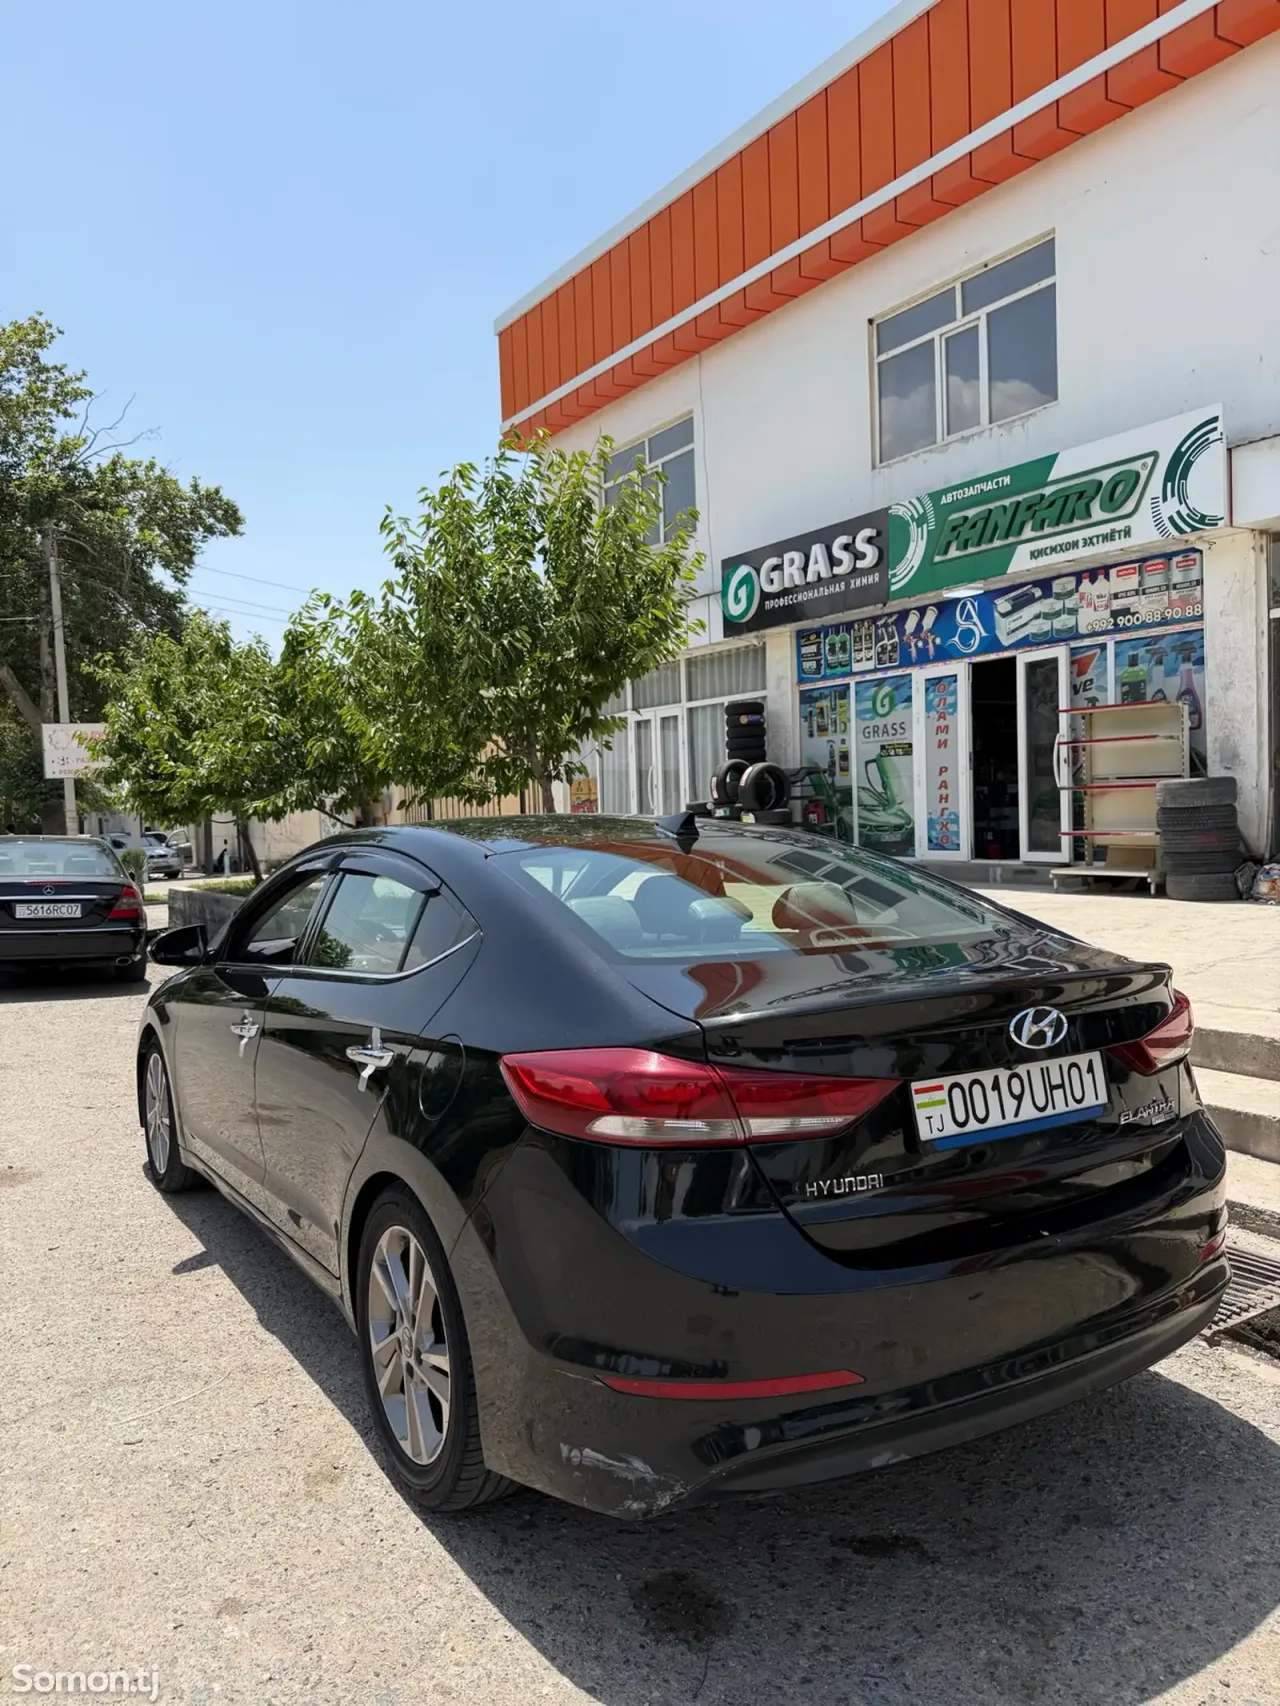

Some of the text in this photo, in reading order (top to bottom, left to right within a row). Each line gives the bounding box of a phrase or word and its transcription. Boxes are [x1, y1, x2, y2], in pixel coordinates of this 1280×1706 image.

[940, 474, 1011, 505] АВТОЗАПЧАСТИ
[935, 468, 1141, 557] FANFARO
[759, 527, 880, 593] GRASS
[764, 572, 880, 611] ПРОФЕССИОНАЛЬНАЯ ХИМИЯ
[1086, 603, 1202, 633] +992 900 88 90 88
[862, 721, 907, 740] GRASS
[947, 1060, 1101, 1129] 0019UH01
[924, 1115, 945, 1134] TJ
[805, 1173, 884, 1197] HYUNDAI
